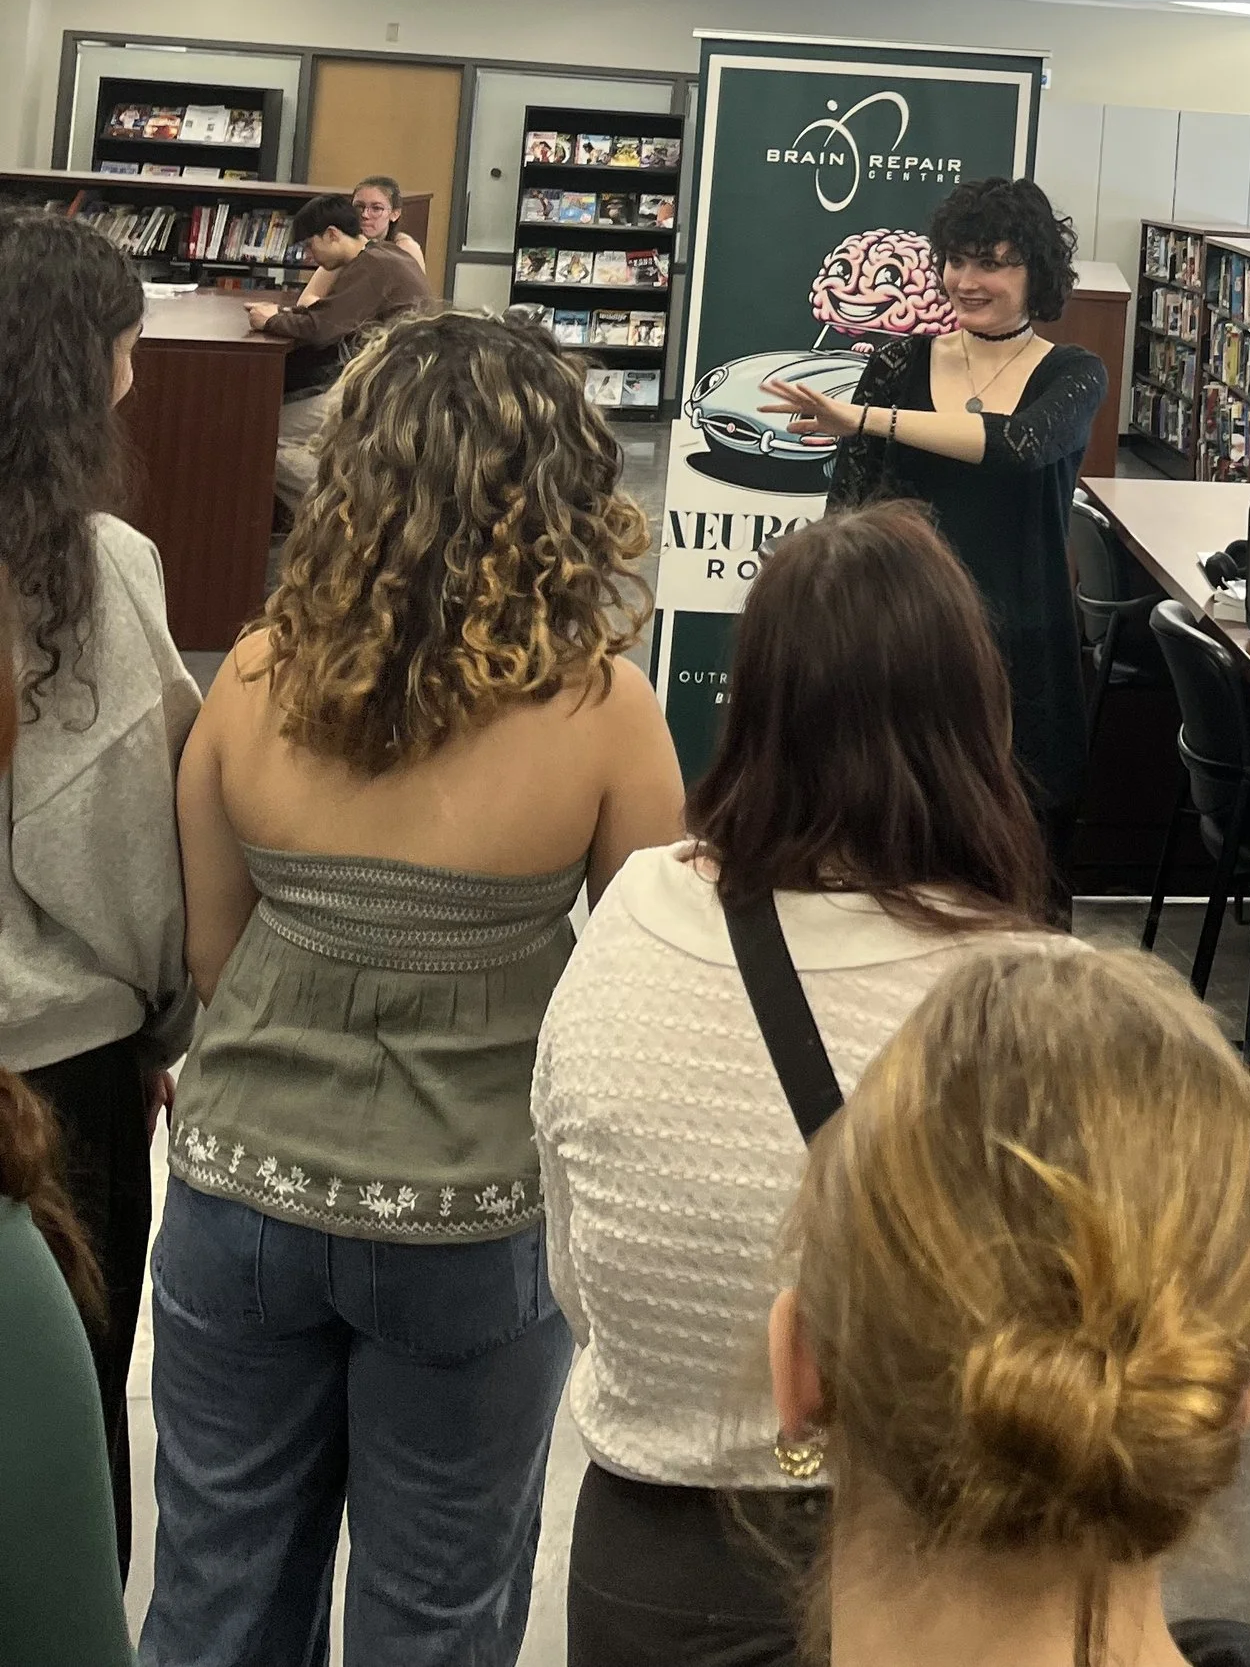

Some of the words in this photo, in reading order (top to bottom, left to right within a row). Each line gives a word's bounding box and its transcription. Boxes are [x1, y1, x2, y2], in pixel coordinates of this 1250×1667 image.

[766, 148, 845, 166] BRAIN
[868, 154, 962, 172] REPAIR
[868, 170, 961, 184] CENTRE
